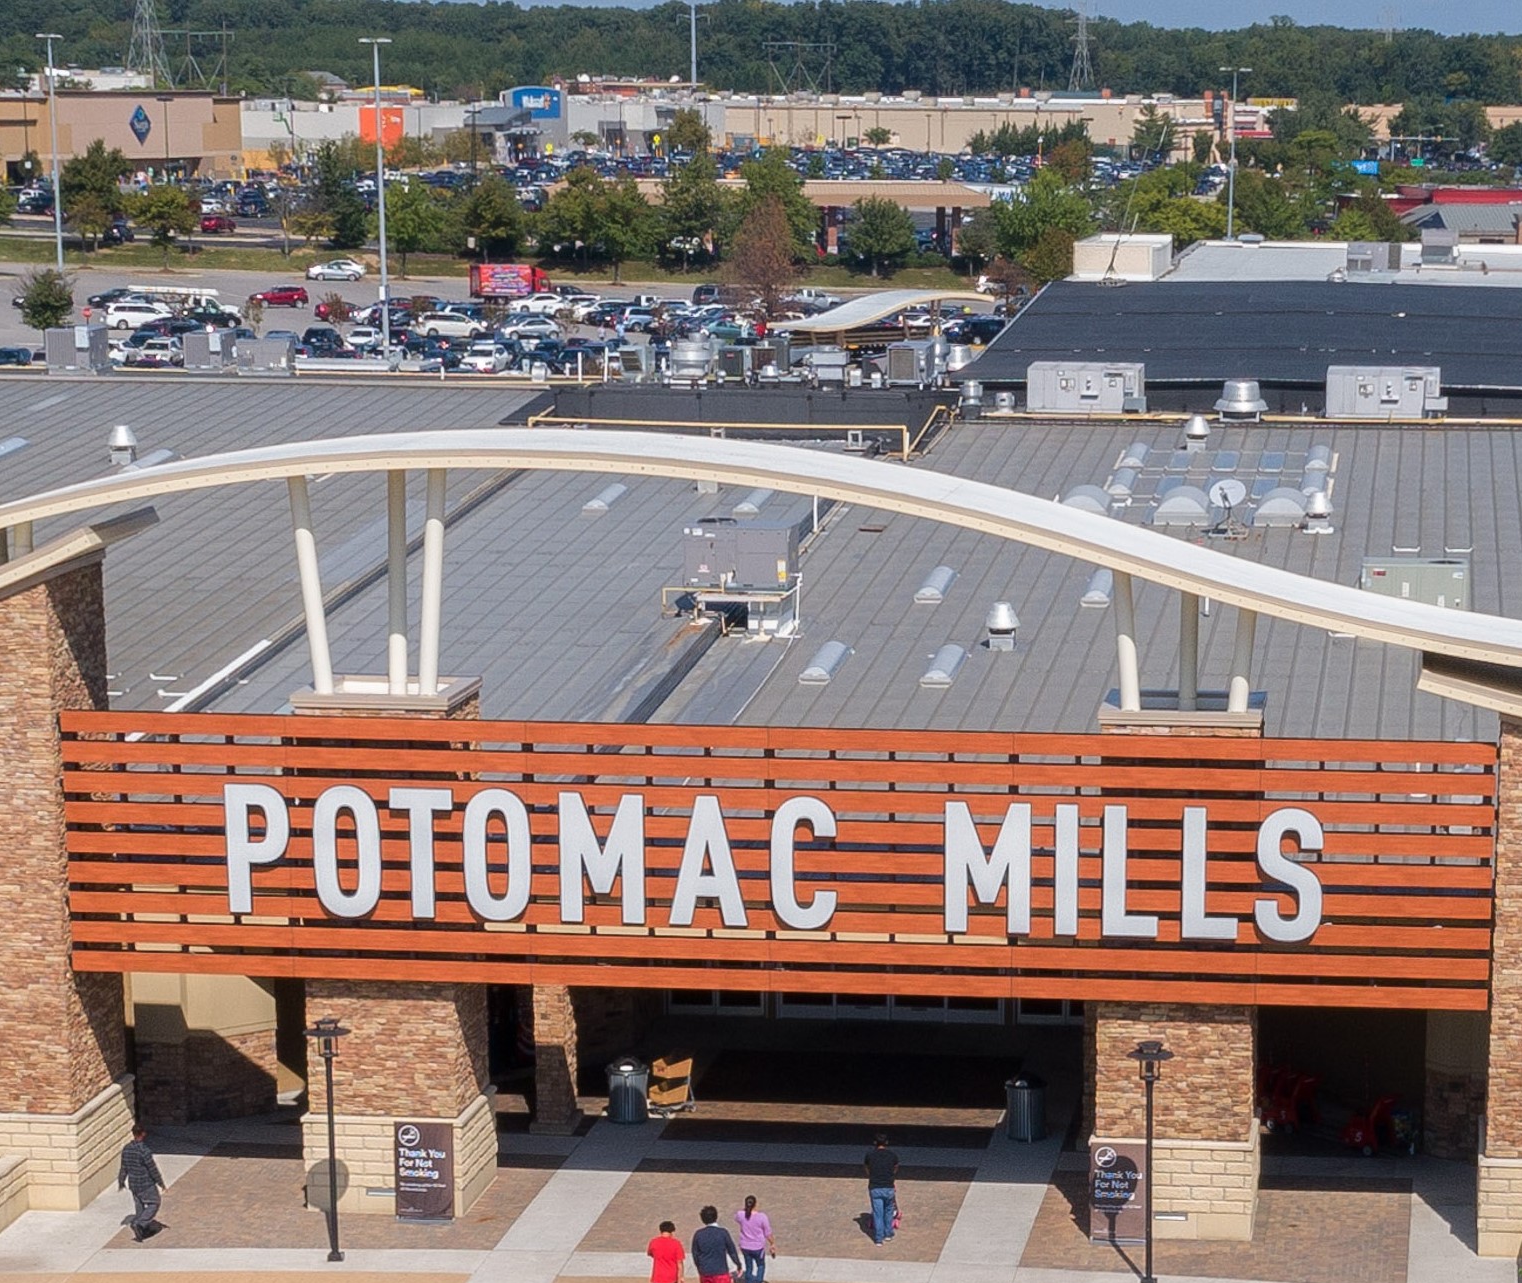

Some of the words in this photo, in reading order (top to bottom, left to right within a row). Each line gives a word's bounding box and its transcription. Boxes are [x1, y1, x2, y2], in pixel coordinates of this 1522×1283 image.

[223, 783, 837, 931] POTOMAC
[945, 801, 1324, 943] MILLS
[398, 1148, 427, 1159] Thank
[428, 1149, 446, 1159] You
[399, 1158, 414, 1168] For
[415, 1158, 433, 1168] Not
[399, 1167, 439, 1180] Smoking
[1094, 1169, 1124, 1180] Thank
[1125, 1171, 1143, 1180] You
[1094, 1180, 1110, 1189] For
[1111, 1180, 1129, 1189] Not
[1094, 1189, 1136, 1201] Smoking
